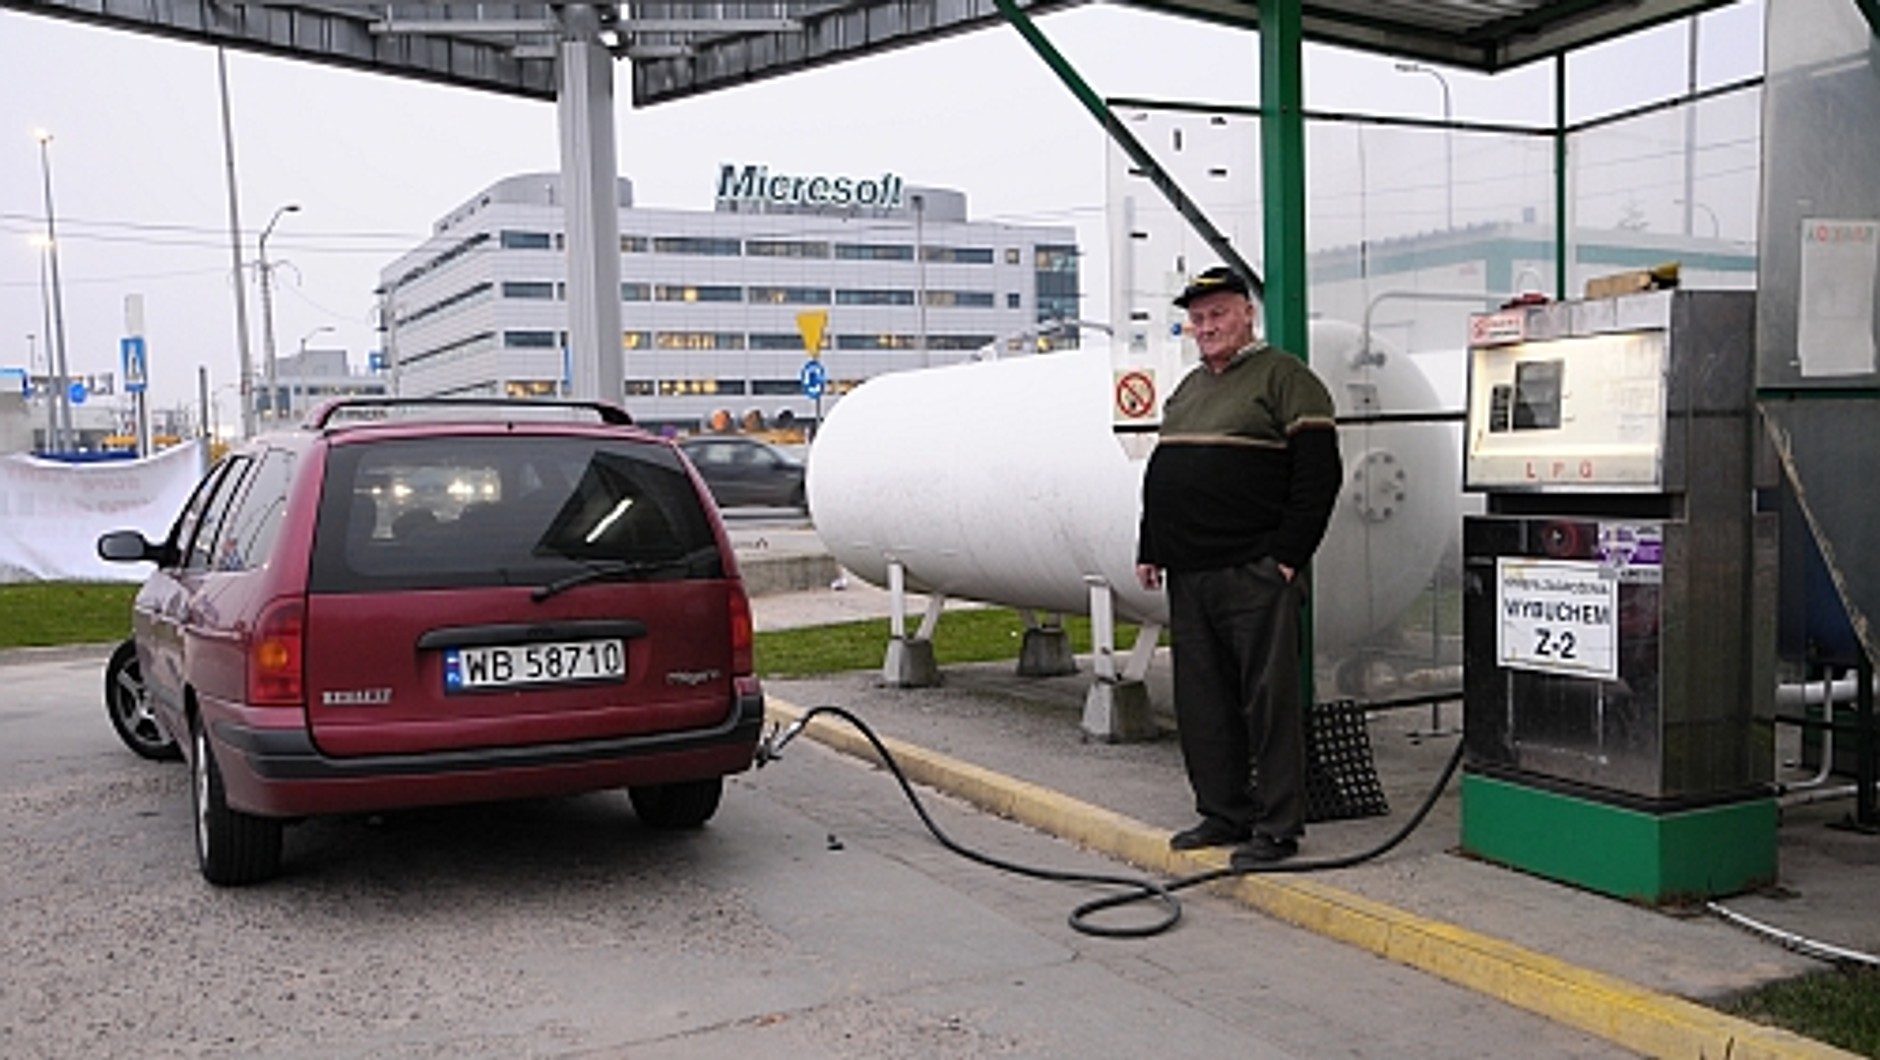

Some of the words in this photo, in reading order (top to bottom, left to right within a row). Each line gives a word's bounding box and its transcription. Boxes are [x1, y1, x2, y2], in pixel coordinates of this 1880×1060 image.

[717, 164, 904, 206] Microsoft
[1504, 597, 1610, 626] WYBUCHEM
[465, 648, 514, 683] WB
[525, 641, 623, 681] 58710
[1534, 627, 1578, 661] Z-2
